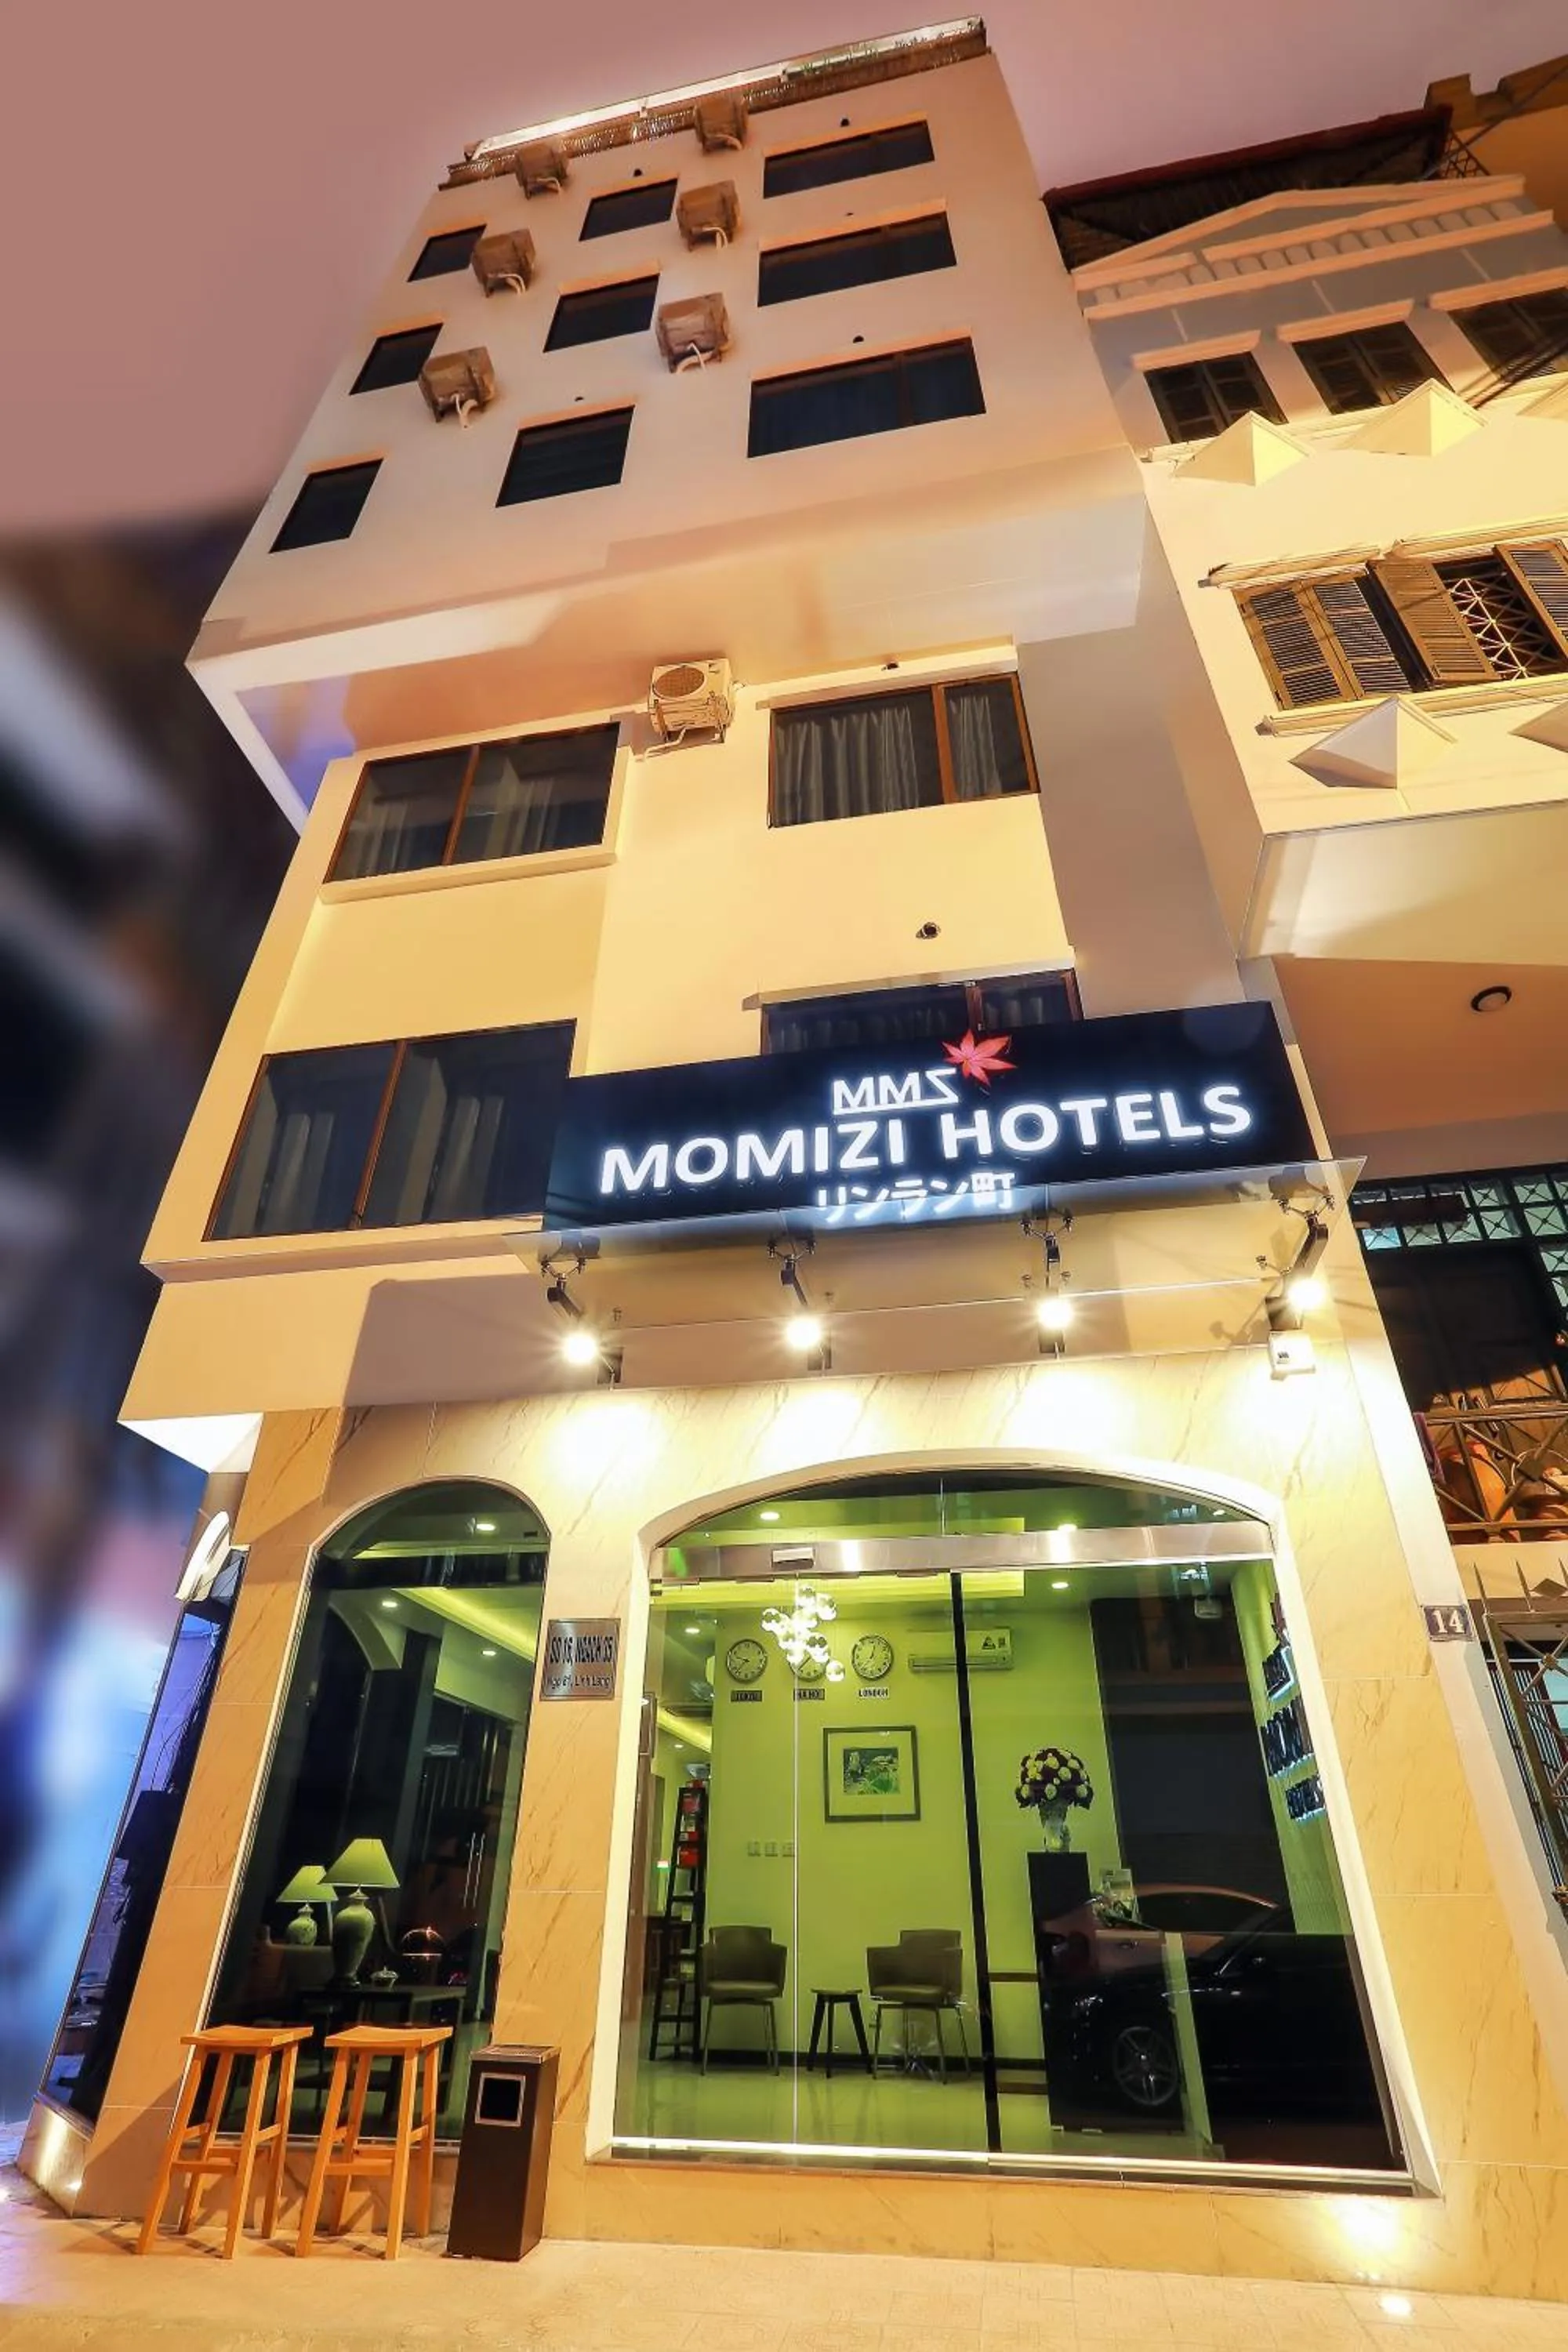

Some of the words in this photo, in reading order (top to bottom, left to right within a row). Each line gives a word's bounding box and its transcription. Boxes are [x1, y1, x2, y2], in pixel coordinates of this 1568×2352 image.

[600, 1117, 906, 1195] MOMIZI
[940, 1085, 1253, 1160] HOTELS
[817, 1171, 1016, 1224] リンラン町
[1432, 1609, 1466, 1634] 14
